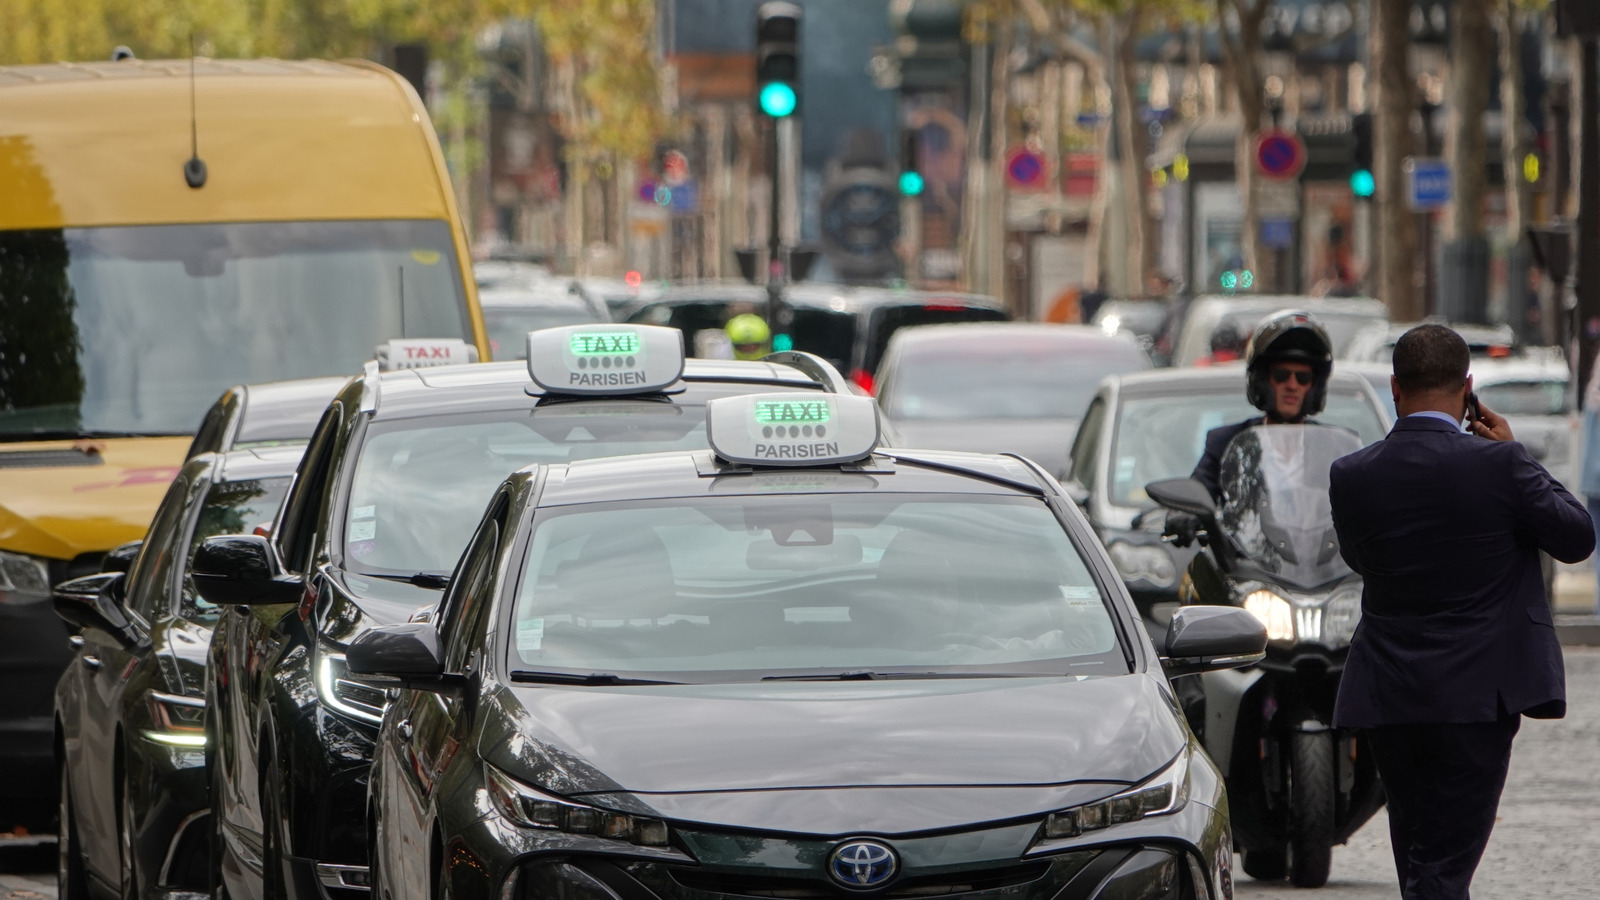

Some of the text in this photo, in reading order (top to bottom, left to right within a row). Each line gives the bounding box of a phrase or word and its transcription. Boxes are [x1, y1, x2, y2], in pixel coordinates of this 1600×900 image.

[404, 346, 451, 359] TAXI
[580, 336, 632, 353] TAXI
[570, 371, 647, 386] PARISIEN
[765, 403, 823, 421] TAXI
[755, 442, 839, 458] PARISIEN
